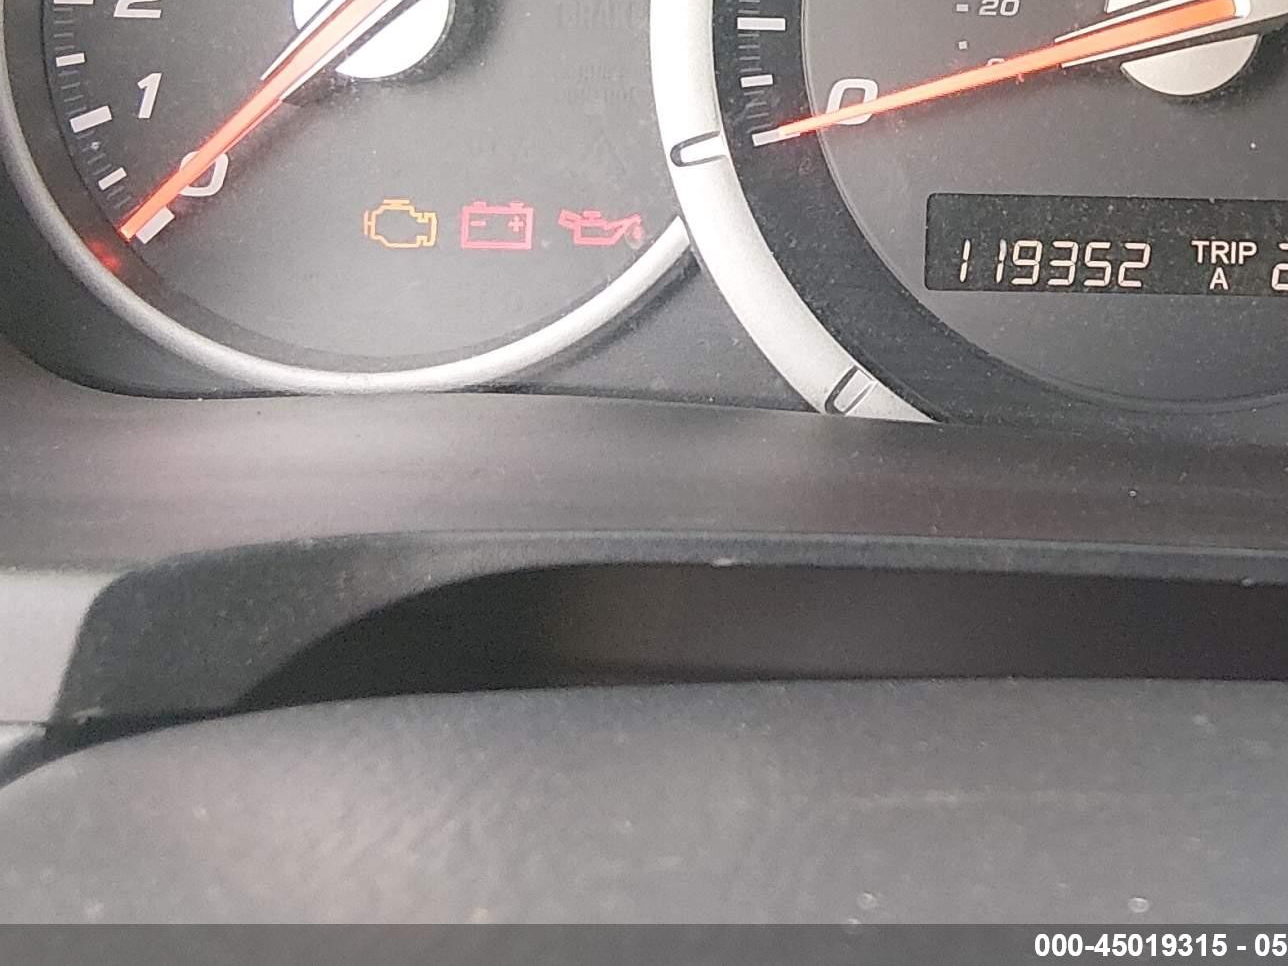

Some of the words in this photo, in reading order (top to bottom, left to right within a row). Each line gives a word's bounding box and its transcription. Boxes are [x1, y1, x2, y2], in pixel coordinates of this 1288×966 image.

[137, 72, 162, 119] 1
[824, 78, 880, 126] 0
[178, 150, 229, 197] 0
[959, 239, 1151, 288] 119352
[1191, 240, 1257, 265] TRIP
[1208, 271, 1230, 291] A
